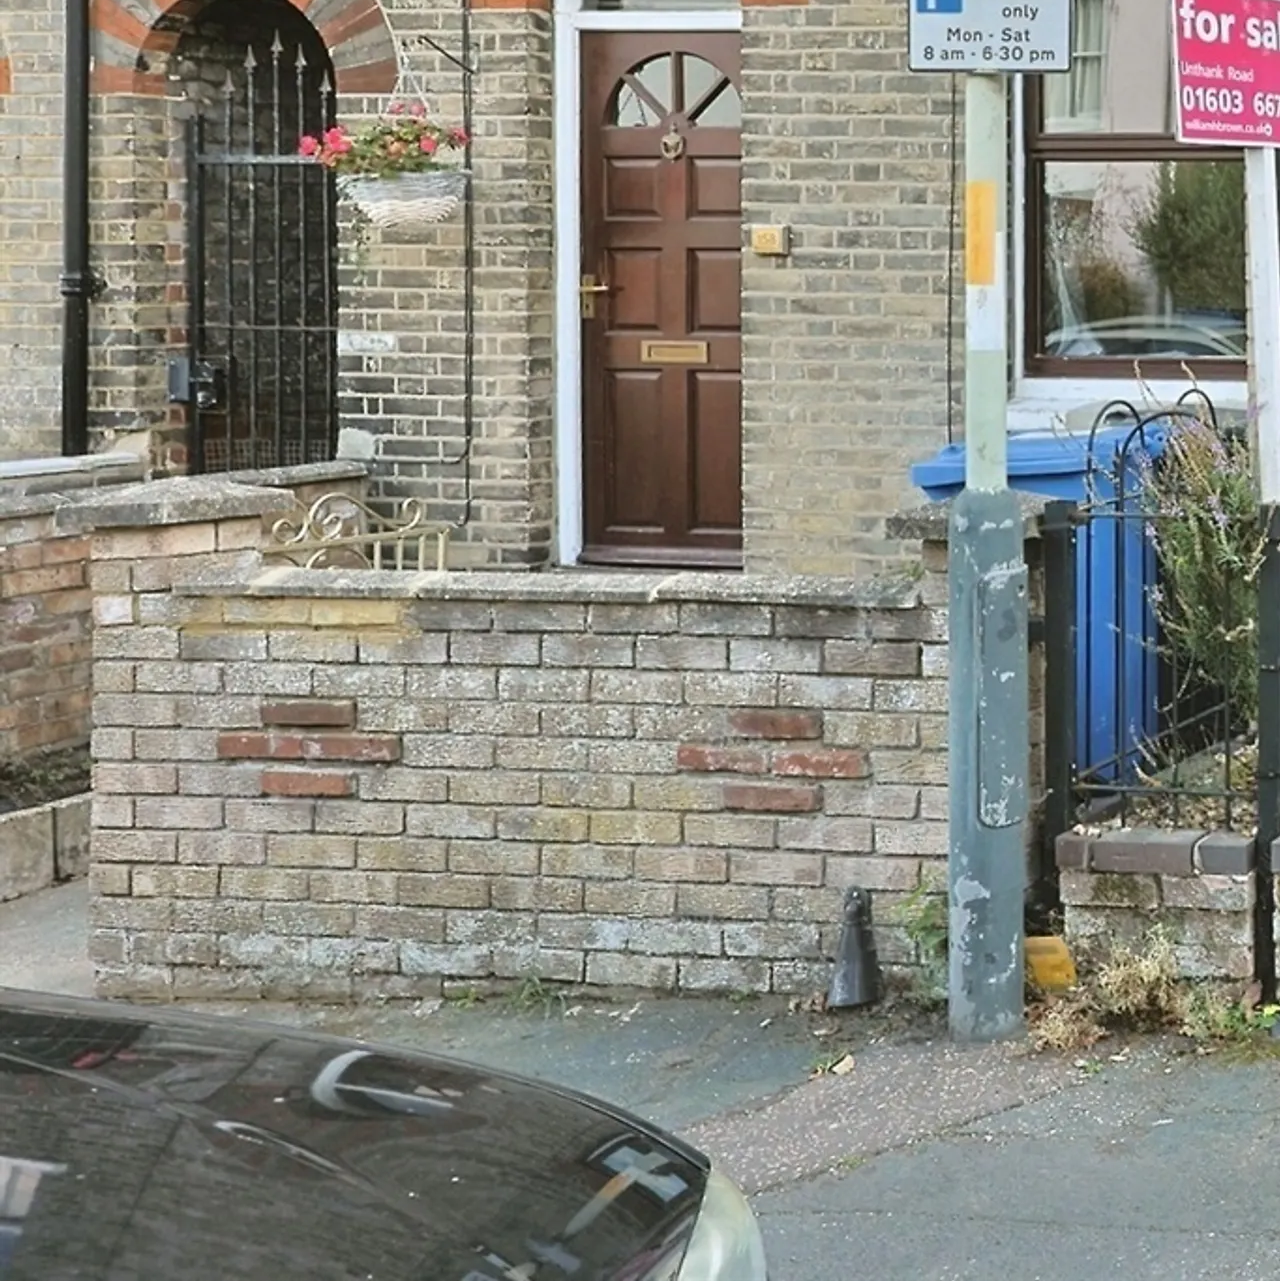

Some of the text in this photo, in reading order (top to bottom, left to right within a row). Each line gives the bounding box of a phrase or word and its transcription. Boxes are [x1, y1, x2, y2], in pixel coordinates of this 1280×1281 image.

[1002, 5, 1039, 21] only
[947, 28, 983, 42] Mon
[1001, 27, 1031, 43] Sat
[923, 45, 934, 61] 8
[940, 49, 965, 61] am
[1029, 50, 1055, 63] pm
[1227, 66, 1254, 83] Road
[1182, 85, 1244, 115] 01603
